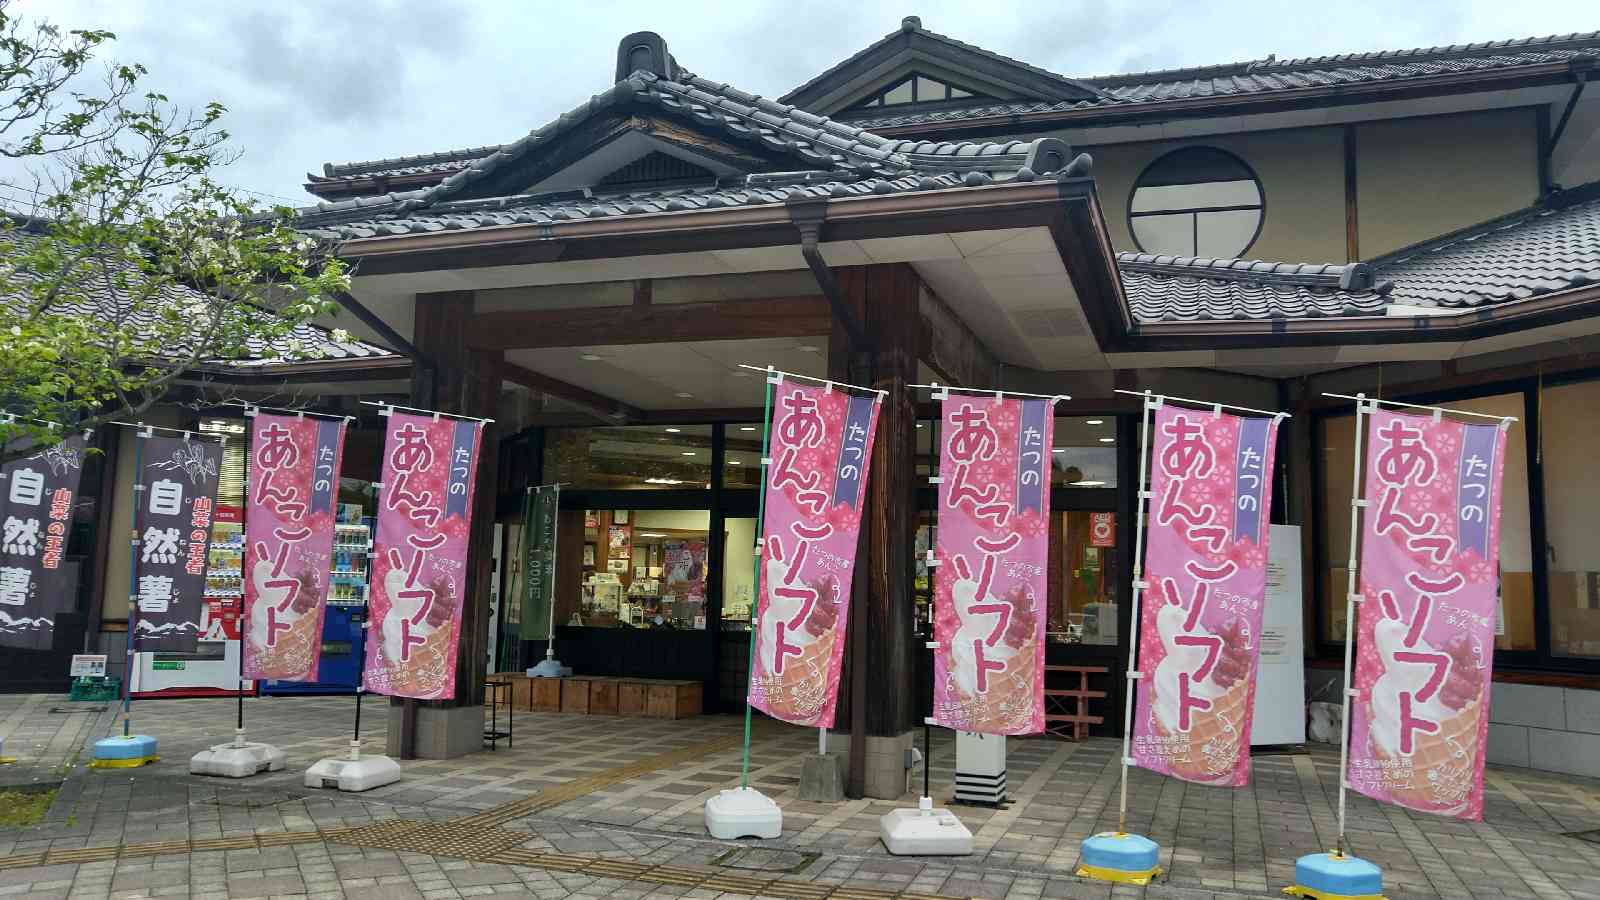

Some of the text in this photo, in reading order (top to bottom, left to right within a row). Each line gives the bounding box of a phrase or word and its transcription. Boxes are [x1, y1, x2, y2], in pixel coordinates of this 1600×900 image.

[315, 444, 333, 492] たつの
[450, 447, 469, 495] たつの
[840, 421, 865, 480] たつの
[1021, 426, 1040, 486] たつの
[1239, 447, 1261, 512] たつの
[1461, 454, 1487, 522] たつの
[0, 468, 44, 605] 自然薯
[138, 478, 183, 613] 自然薯
[185, 496, 212, 575] 山菜の王者
[255, 423, 312, 647] あんこソフト
[387, 422, 447, 662] あんこソフト
[769, 390, 833, 676] あんこソフト
[947, 404, 1022, 693] あんこソフト
[1157, 414, 1238, 733] あんこソフト
[1374, 418, 1465, 756] あんこソフト
